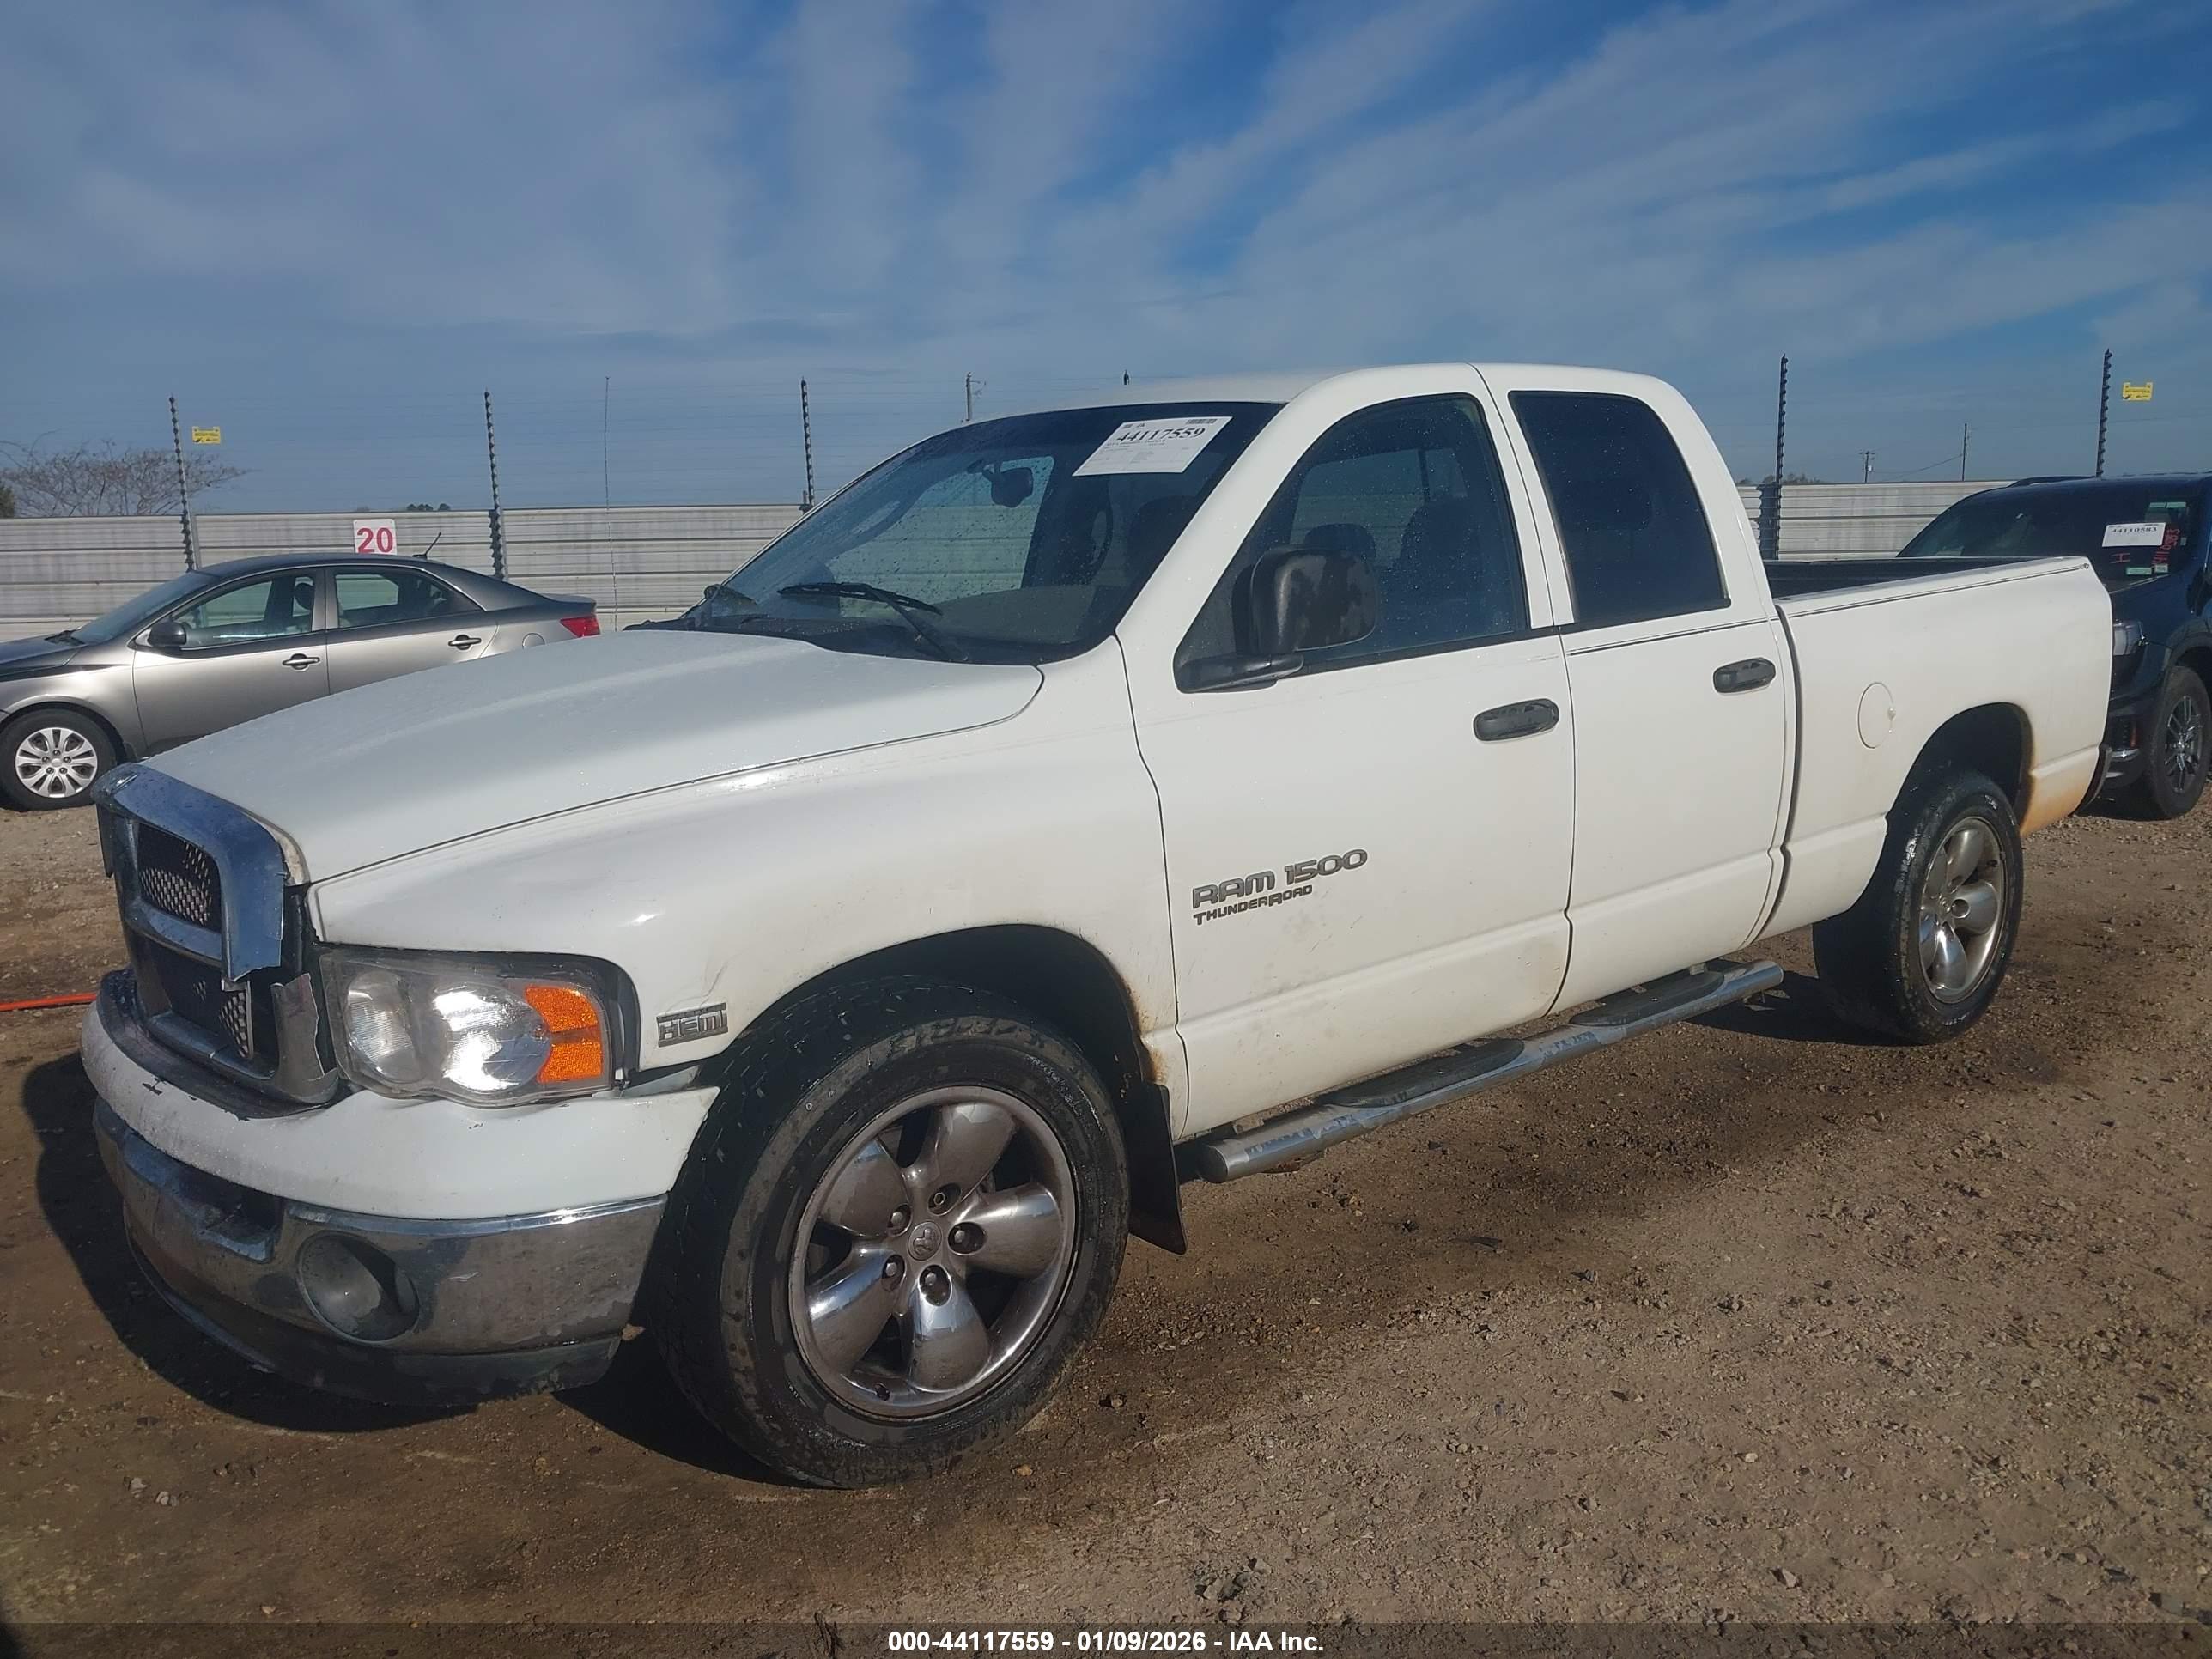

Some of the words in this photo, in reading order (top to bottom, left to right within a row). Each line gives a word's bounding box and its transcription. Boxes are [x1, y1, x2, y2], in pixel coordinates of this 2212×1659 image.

[1116, 427, 1206, 442] 44117559
[356, 527, 393, 553] 20
[1192, 870, 1276, 909] RAM
[1284, 848, 1368, 886] 1500
[657, 1007, 728, 1042] HEMI
